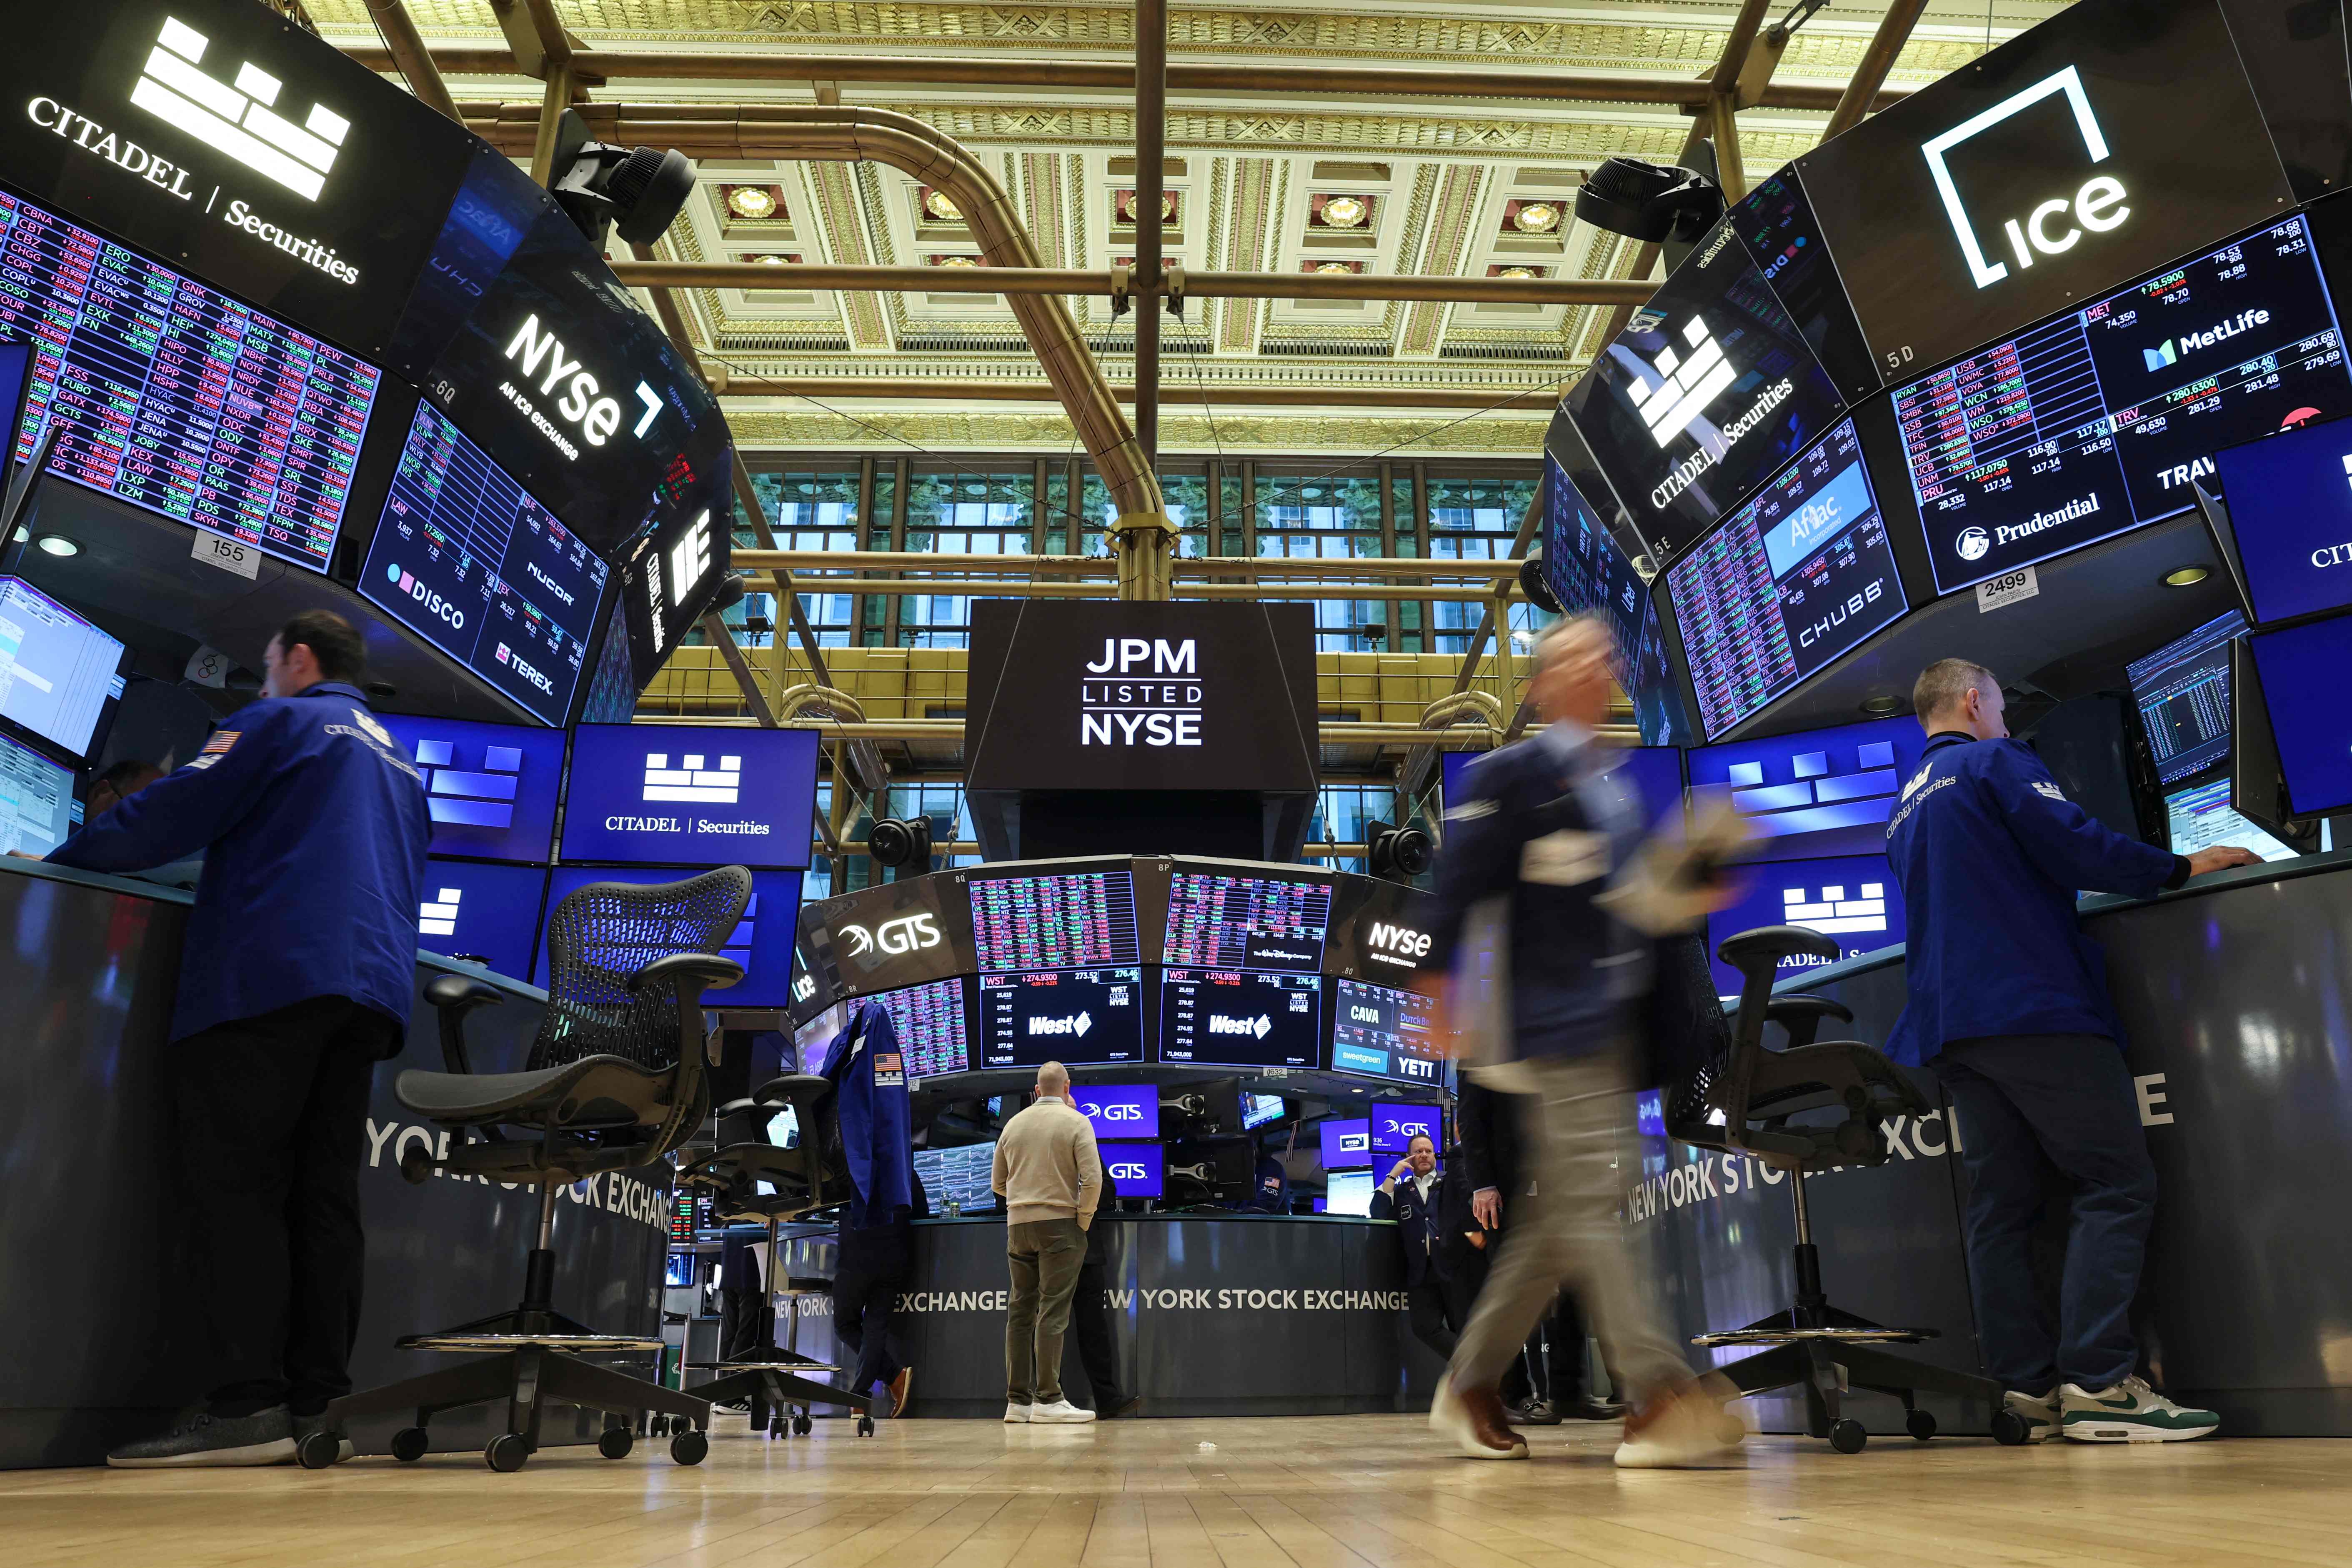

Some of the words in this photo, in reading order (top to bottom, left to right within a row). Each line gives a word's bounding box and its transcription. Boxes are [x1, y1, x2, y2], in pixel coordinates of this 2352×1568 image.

[27, 97, 193, 200] CITADEL
[224, 199, 360, 285] Securities
[23, 206, 53, 226] CBNA
[71, 228, 99, 245] 32.9100
[10, 243, 41, 262] CHGG
[106, 245, 130, 263] ERO
[150, 265, 176, 281] 30.0000
[2087, 302, 2111, 320] MET
[2147, 270, 2184, 292] 78.5900
[2213, 246, 2241, 265] 78.53
[2270, 220, 2300, 240] 78.68
[2105, 310, 2136, 329] 74,350
[2162, 288, 2189, 305] 78.70
[2217, 263, 2246, 282] 78.88
[2276, 238, 2306, 257] 78.31
[2120, 319, 2138, 329] VOLUME
[2178, 296, 2191, 305] OPEN
[2236, 272, 2247, 281] HIGH
[2295, 247, 2307, 255] LOW
[253, 313, 276, 330] MAIN
[2179, 308, 2270, 355] MetLife
[319, 345, 342, 361] PEW
[1957, 361, 1976, 375] USB
[1959, 368, 1985, 385] UWMC
[2115, 407, 2139, 425] TRV
[2172, 378, 2216, 402] 280.6300
[2239, 355, 2274, 376] 280.40
[2299, 332, 2335, 353] 280.69
[63, 378, 91, 395] FUBO
[499, 381, 517, 400] AN
[1896, 385, 1917, 400] RYAN
[1964, 392, 1988, 407] WCN
[2135, 417, 2166, 435] 49,630
[2187, 396, 2221, 415] 281.29
[2244, 374, 2279, 393] 281.48
[2304, 350, 2341, 371] 279.69
[1651, 446, 1717, 510] CITADEL
[1721, 377, 1794, 446] Securities
[1922, 485, 1944, 499] PRU
[1970, 459, 2008, 480] 117.0750
[2027, 441, 2057, 458] 116.90
[2077, 420, 2106, 439] 117.17
[1938, 494, 1966, 510] 28,332
[1983, 475, 2012, 493] 117.14
[2032, 457, 2061, 475] 117.14
[2081, 438, 2112, 456] 116.50
[390, 496, 408, 515] LAW
[1755, 497, 1766, 509] AFL
[194, 512, 219, 528] SKYH
[1792, 496, 1837, 547] Aflac
[1809, 517, 1841, 545] Incorporated
[1994, 492, 2100, 545] Prudential
[213, 540, 245, 561] 155
[268, 526, 288, 541] TSQ
[310, 542, 328, 554] 5.5683
[527, 561, 573, 606] NUCOR
[1621, 580, 1636, 613] Uber
[1985, 573, 2026, 597] 2499
[411, 580, 464, 629] DISCO
[1799, 580, 1882, 648] CHUBB
[1983, 601, 2000, 609] CITADEL
[1086, 638, 1195, 673] JPM
[511, 653, 553, 695] TEREX
[1083, 685, 1202, 703] LISTED
[1082, 713, 1202, 746] NYSE
[1886, 803, 1911, 840] CITADEL
[1916, 775, 1956, 805] Securities
[605, 816, 681, 833] CITADEL
[697, 819, 770, 835] Securities
[877, 913, 941, 955] GTS
[986, 976, 1005, 985] WST
[1115, 970, 1138, 978] 276.46
[1169, 971, 1189, 980] WST
[1210, 973, 1241, 981] 274.9300
[1258, 975, 1280, 983] 273.52
[1296, 977, 1318, 985] 276.46
[1029, 1015, 1074, 1035] West
[1209, 1015, 1254, 1035] West
[1351, 1005, 1379, 1024] CAVA
[1342, 1052, 1381, 1064] sweetgreen
[1398, 1057, 1434, 1078] YETI
[607, 1172, 672, 1233] EXCHANG
[1628, 1178, 1656, 1225] NEW
[1659, 1157, 1718, 1211] YORK
[797, 1297, 828, 1317] YORK
[1141, 1289, 1211, 1309] YORK
[1218, 1288, 1297, 1310] STOCK
[1304, 1290, 1409, 1311] EXCHANGE
